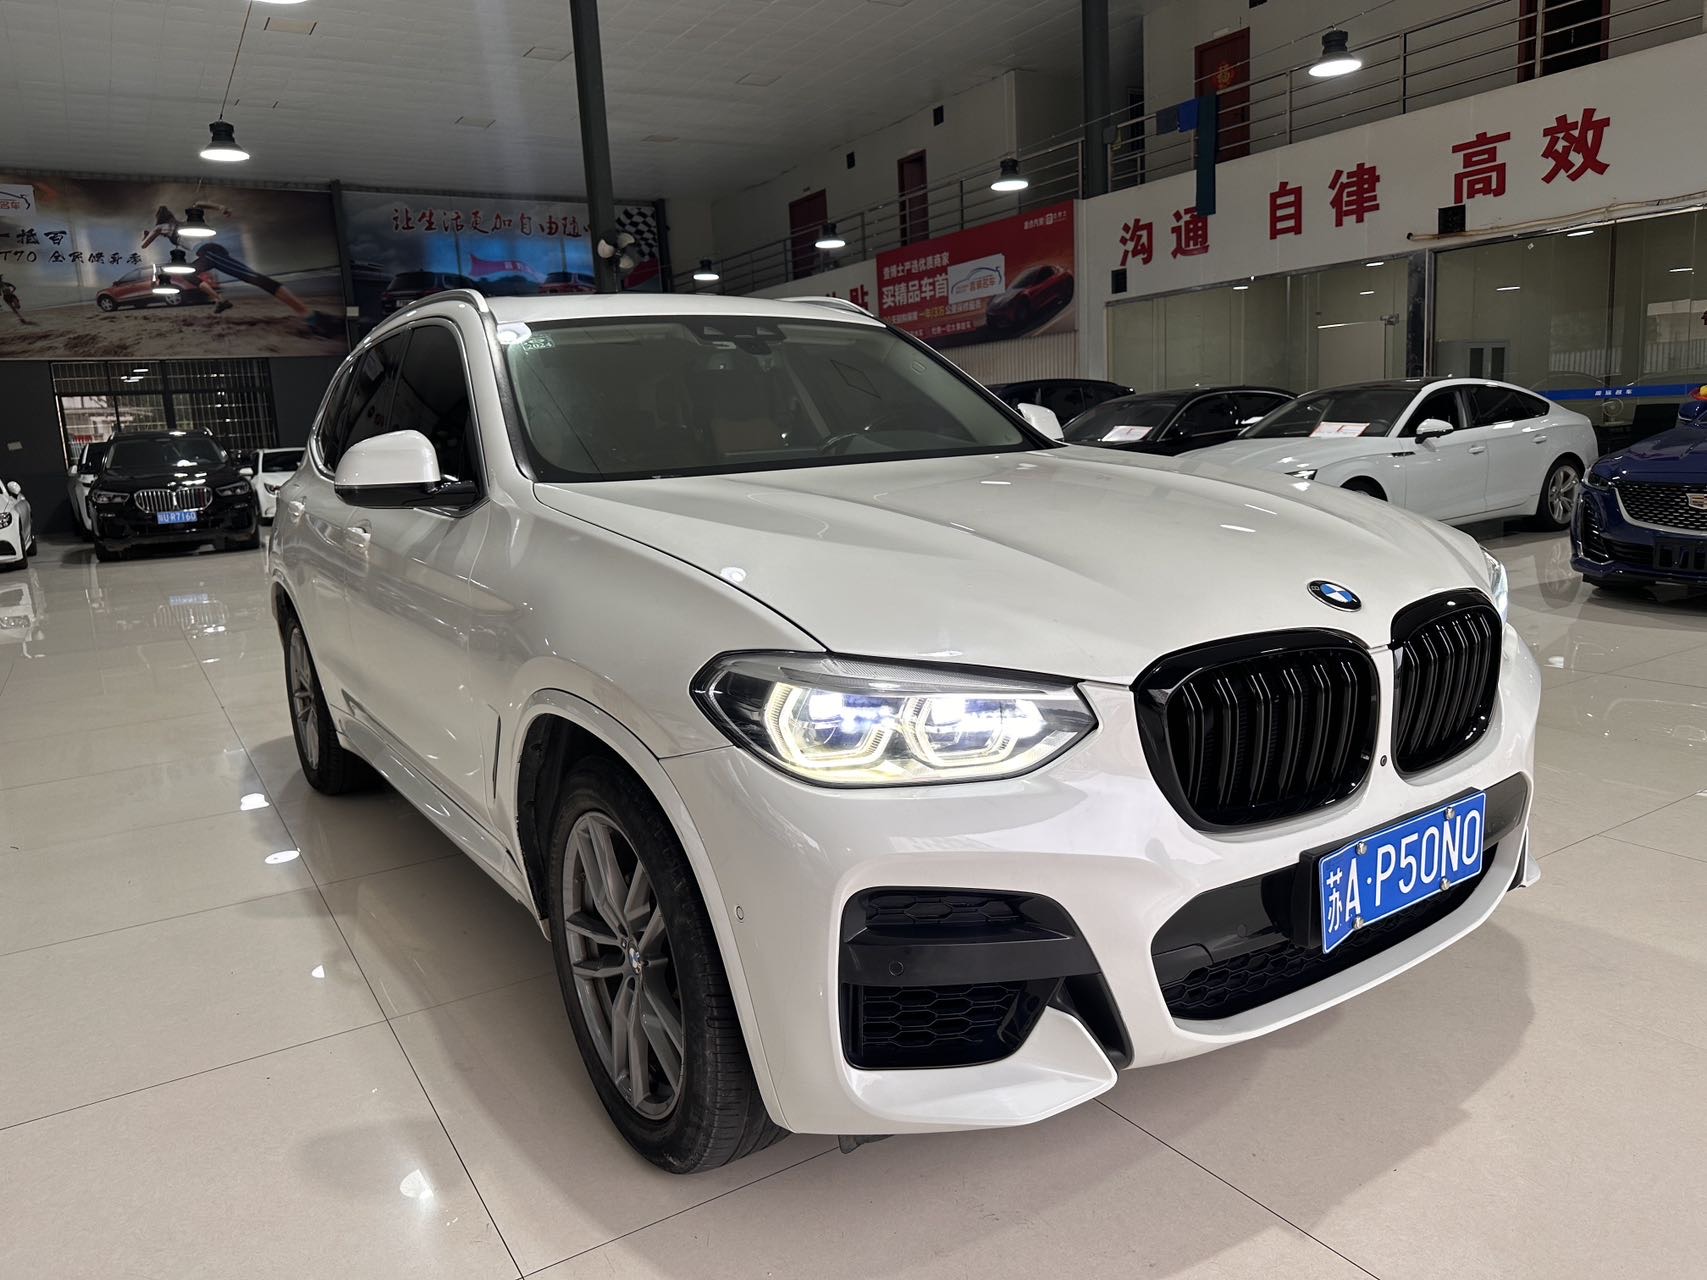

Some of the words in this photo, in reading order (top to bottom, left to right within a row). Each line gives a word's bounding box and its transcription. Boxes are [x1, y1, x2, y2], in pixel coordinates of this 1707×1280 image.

[1119, 204, 1210, 266] 沟通
[1268, 162, 1381, 240] 自律
[1451, 107, 1611, 204] 高效
[882, 272, 948, 309] 买精品车首
